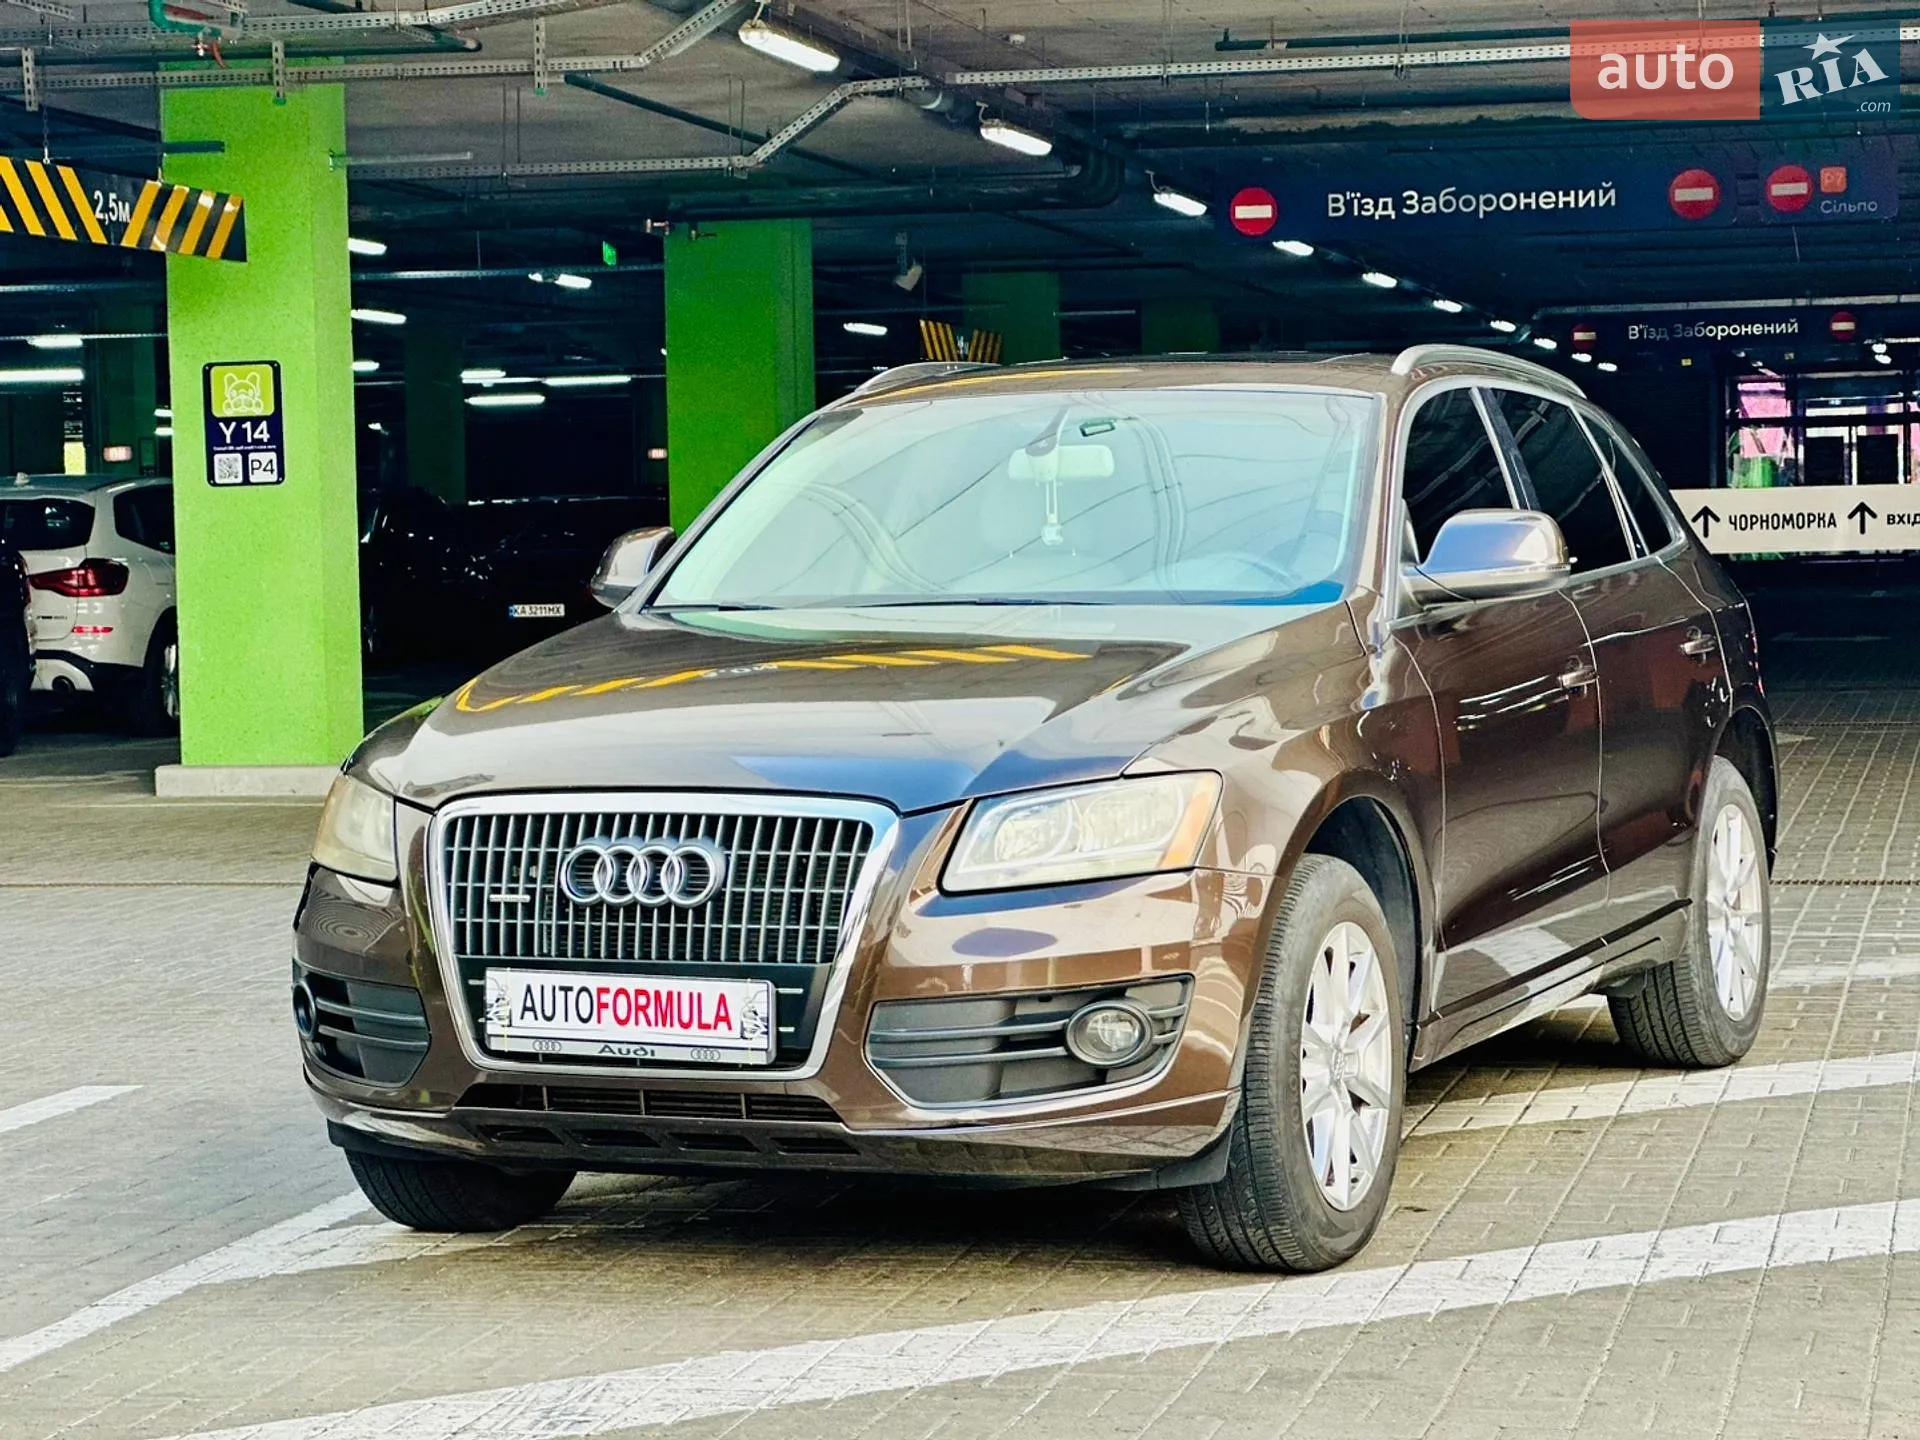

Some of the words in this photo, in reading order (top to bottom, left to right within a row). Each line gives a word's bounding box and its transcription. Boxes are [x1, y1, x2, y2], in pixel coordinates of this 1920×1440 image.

[1327, 191, 1396, 220] В'їзд
[1402, 181, 1617, 219] Заборонений
[1820, 199, 1878, 214] Сільпо
[1628, 324, 1669, 341] В'їзд
[1673, 318, 1799, 341] Заборонений
[218, 421, 237, 444] Y
[241, 420, 271, 443] 14
[250, 458, 275, 475] P4
[1728, 512, 1837, 531] ЧОРНОМОРКА
[520, 983, 733, 1031] AUTOFORMULA
[598, 1044, 655, 1057] Audi
